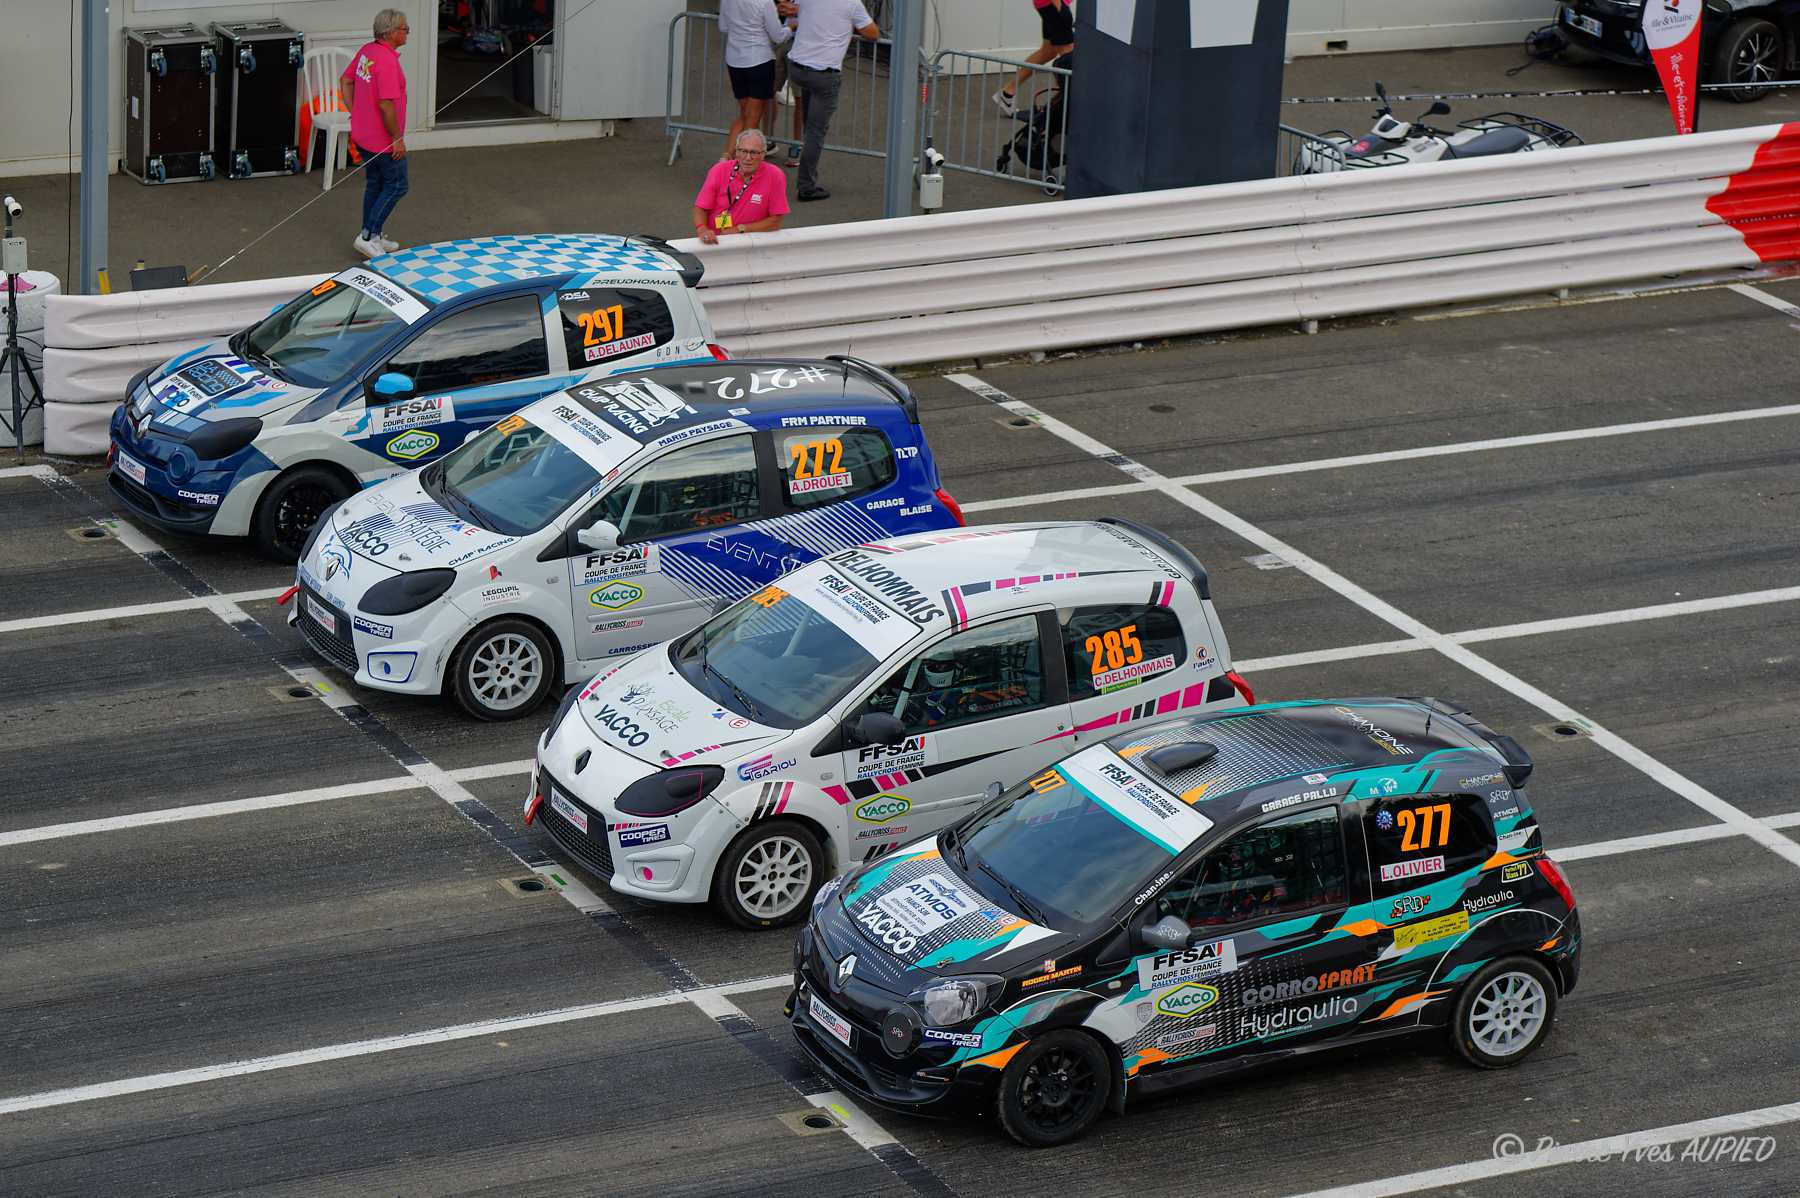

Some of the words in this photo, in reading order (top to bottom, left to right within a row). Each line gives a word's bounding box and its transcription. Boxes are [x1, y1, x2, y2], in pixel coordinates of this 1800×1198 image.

[578, 305, 623, 347] 297
[588, 335, 652, 360] A.DELAUNAY
[708, 366, 831, 400] #272
[384, 400, 437, 418] FFSA
[552, 405, 577, 422] FFSA
[383, 418, 404, 428] COUPE
[417, 411, 441, 421] FRANCE
[781, 417, 808, 427] FRM
[810, 416, 867, 426] PARTNER
[659, 431, 687, 447] MARIS
[689, 421, 735, 440] PAYSAGE
[395, 437, 434, 452] YACCO
[790, 438, 847, 480] 272
[791, 474, 850, 493] A.DROUET
[178, 490, 219, 501] COOPER
[866, 497, 905, 510] GARAGE
[900, 504, 932, 516] BLAISE
[342, 521, 389, 556] YACCO
[586, 548, 642, 568] FFSA
[707, 532, 778, 569] EVENT
[585, 568, 609, 578] COUPE
[621, 562, 648, 572] FRANCE
[481, 585, 520, 597] LEGOUPIL
[819, 574, 848, 597] FFSA
[829, 549, 944, 625] DELHOMMAIS
[483, 591, 521, 602] INDUSTRIE
[596, 589, 639, 602] YACCO
[354, 617, 392, 634] COOPER
[1085, 624, 1143, 676] 285
[1094, 657, 1173, 688] C.DELHOMMAIS
[594, 704, 650, 747] YACCO
[859, 738, 919, 763] FFSA
[857, 767, 898, 780] RALLYCROSS
[898, 761, 925, 770] FEMININE
[858, 763, 883, 773] COUPE
[897, 754, 925, 766] FRANCE
[1099, 762, 1131, 787] FFSA
[862, 802, 906, 816] YACCO
[1262, 795, 1302, 813] GARAGE
[1303, 787, 1337, 802] PALLU
[620, 826, 666, 841] COOPER
[1396, 803, 1451, 852] 277
[642, 834, 666, 843] TIRES
[1381, 858, 1443, 880] L.OLIVIER
[906, 883, 957, 921] ATMOS
[857, 903, 917, 954] YACCO
[1153, 944, 1216, 971] FFSA
[1050, 965, 1082, 980] MARTIN
[1152, 971, 1178, 982] COUPE
[1180, 968, 1191, 976] DE
[1192, 961, 1222, 973] FRANCE
[1152, 975, 1194, 989] RALLYCROSS
[1164, 991, 1211, 1009] YACCO
[1240, 996, 1358, 1038] Hydraulia
[925, 1029, 982, 1042] COOPER
[952, 1039, 980, 1048] TIRES
